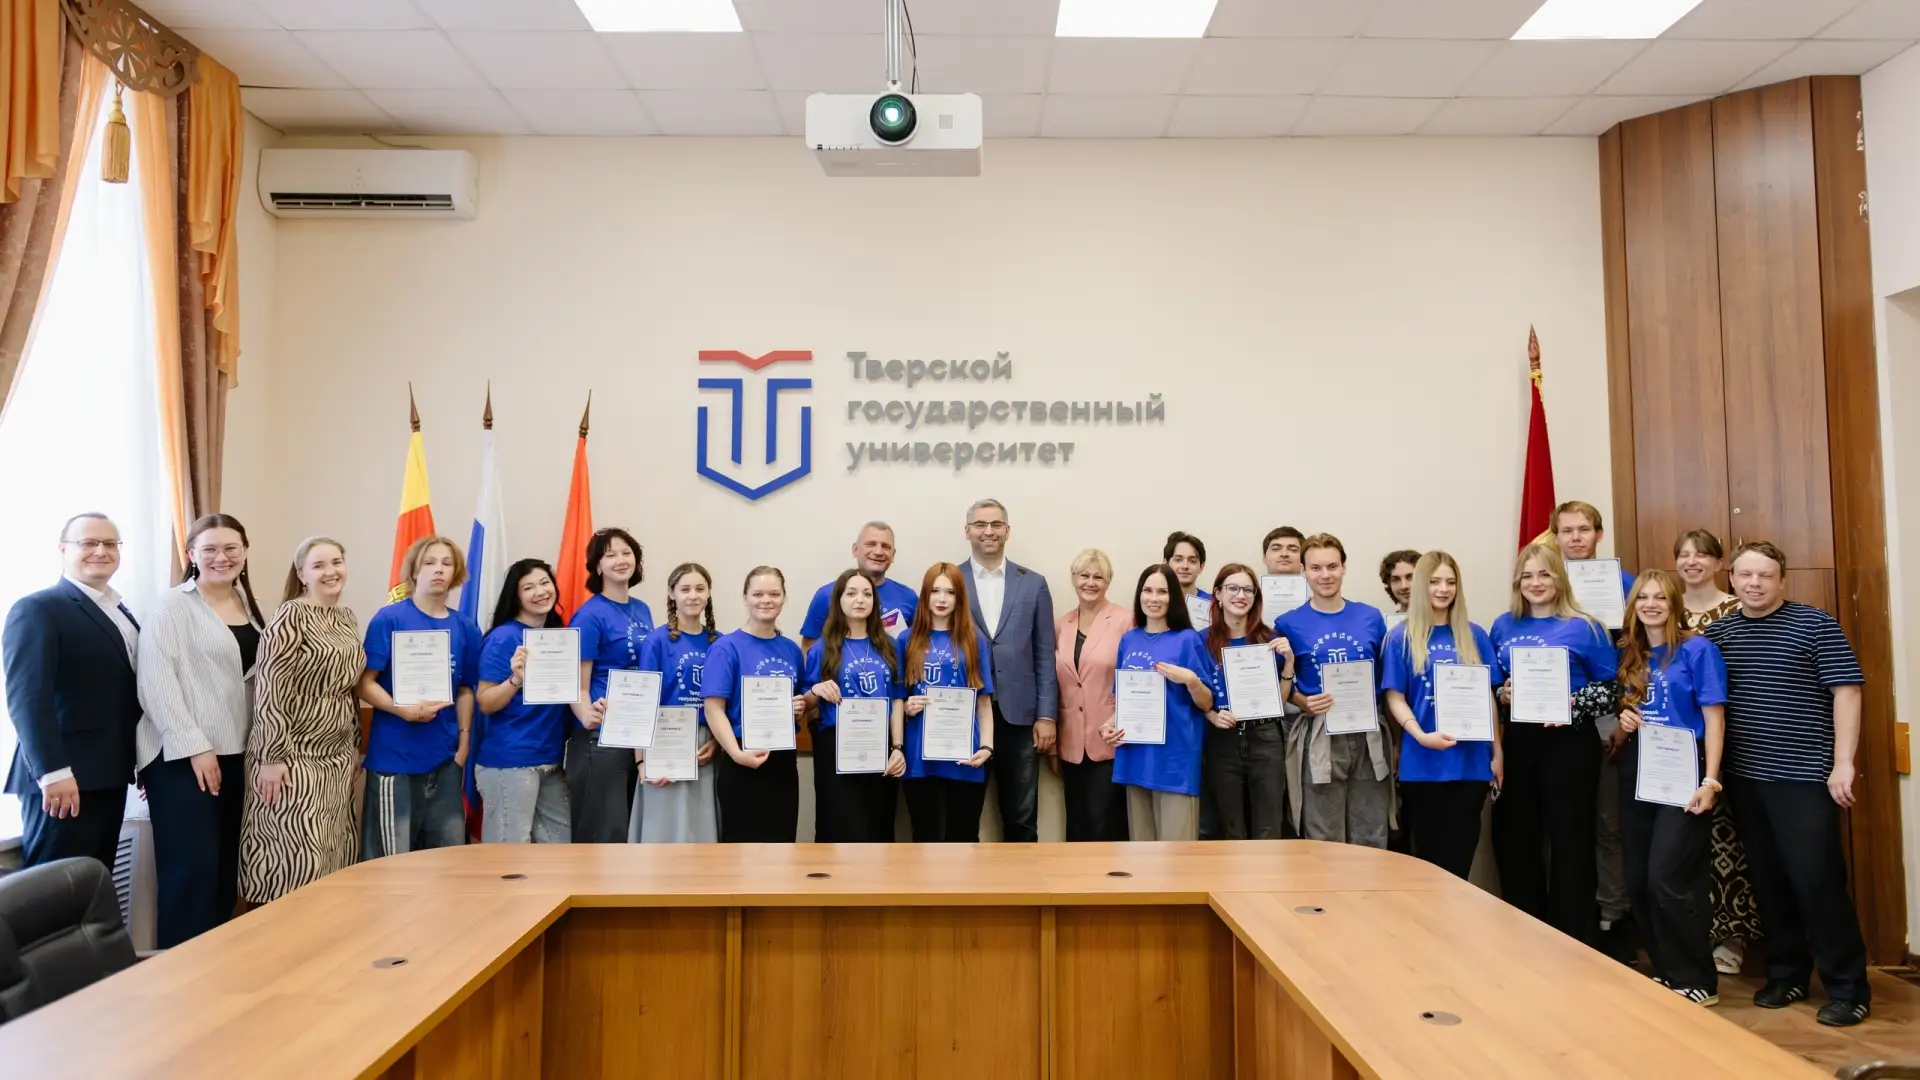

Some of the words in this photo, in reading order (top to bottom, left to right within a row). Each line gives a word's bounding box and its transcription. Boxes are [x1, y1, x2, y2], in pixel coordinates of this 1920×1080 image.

[847, 351, 1012, 388] Тверской
[847, 392, 1165, 430] государственный
[845, 442, 1075, 471] университет
